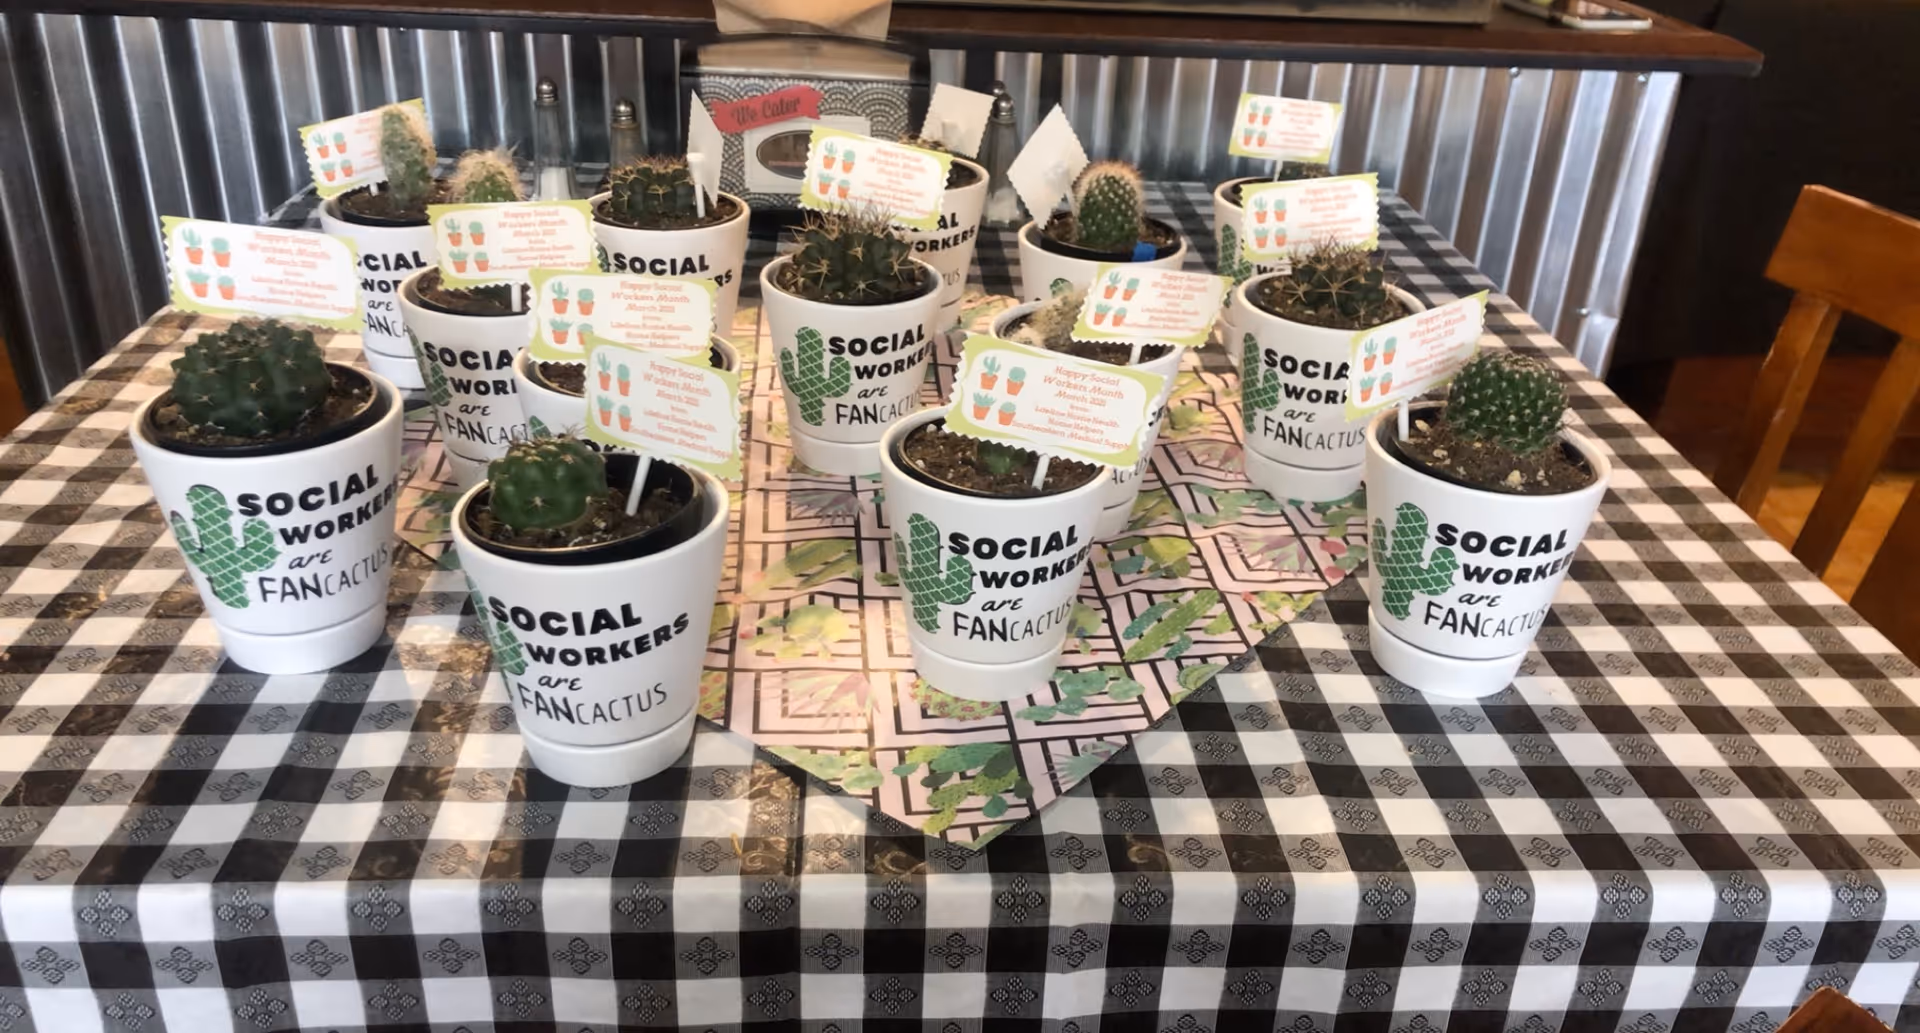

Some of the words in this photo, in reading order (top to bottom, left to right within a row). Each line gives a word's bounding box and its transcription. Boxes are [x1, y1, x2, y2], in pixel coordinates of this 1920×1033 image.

[761, 97, 801, 119] Cater
[911, 225, 975, 252] ORKERS
[613, 252, 709, 276] SOCIAL
[368, 300, 394, 311] are
[829, 323, 924, 357] SOCIAL
[423, 341, 516, 371] SOCIA
[1264, 348, 1350, 381] SOCIA
[1055, 366, 1087, 381] Happy
[1089, 373, 1120, 387] Social
[857, 385, 888, 399] are
[1055, 390, 1087, 404] March
[1089, 386, 1124, 399] Month
[459, 404, 491, 416] are
[1284, 409, 1316, 423] are
[237, 464, 378, 517] SOCIAL
[948, 524, 1078, 561] SOCIAL
[1435, 523, 1567, 558] SOCIAL
[288, 550, 332, 570] are
[981, 598, 1023, 612] are
[1458, 593, 1502, 608] are
[488, 596, 642, 637] SOCIAL
[524, 612, 689, 667] WORKERS
[538, 675, 583, 691] are
